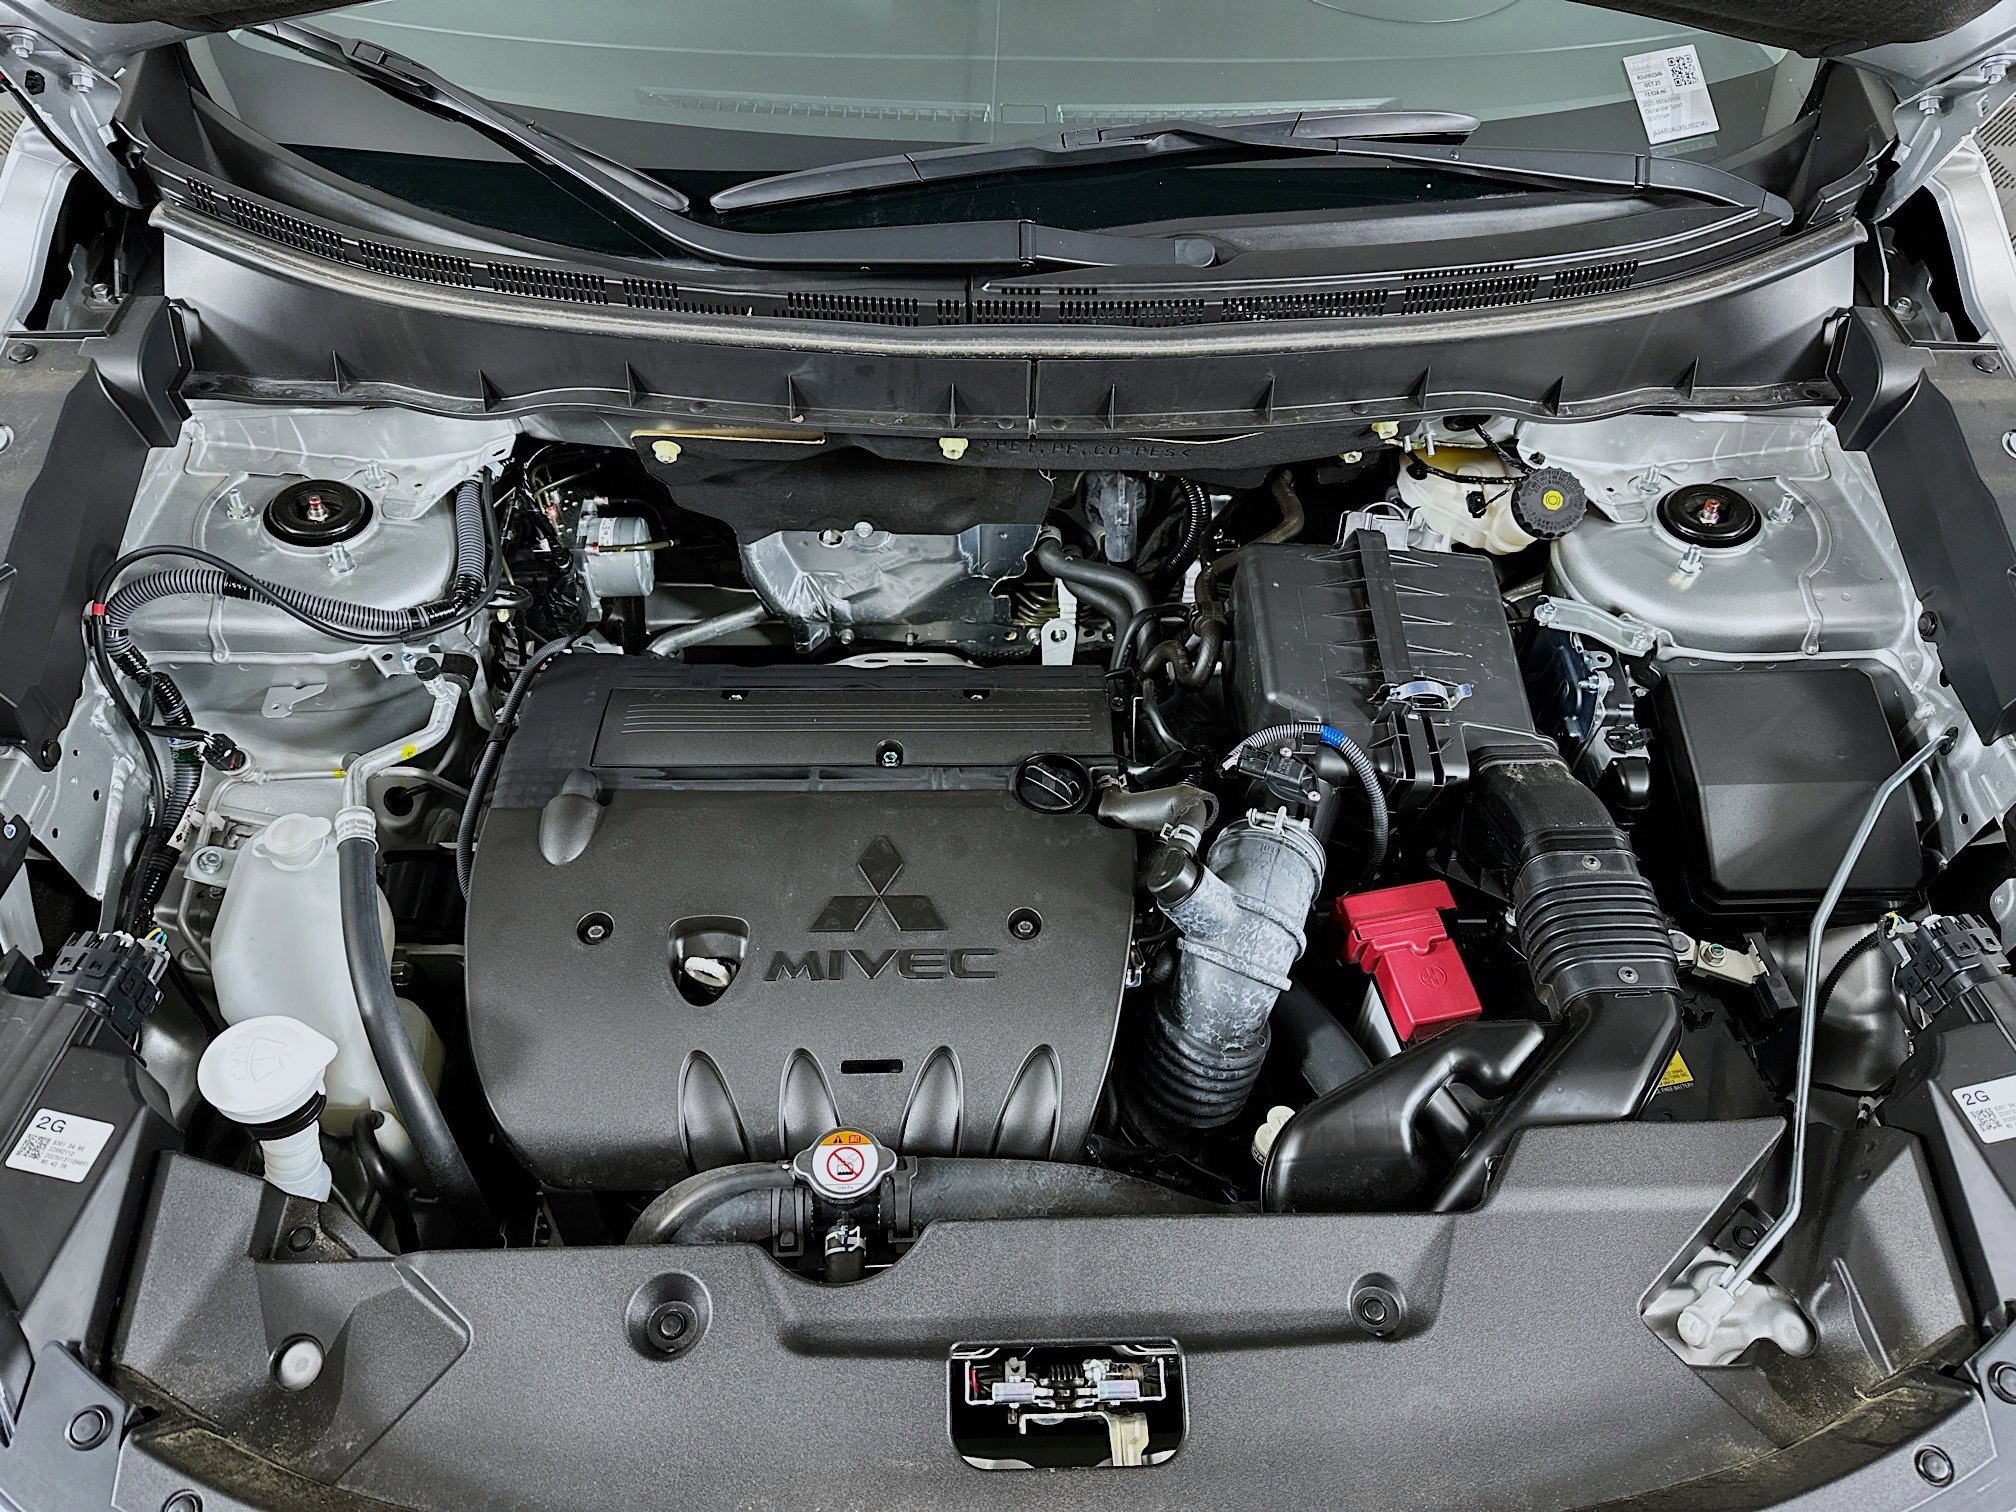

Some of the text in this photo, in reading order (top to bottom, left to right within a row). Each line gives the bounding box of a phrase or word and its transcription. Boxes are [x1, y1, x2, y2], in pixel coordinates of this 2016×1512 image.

[763, 948, 997, 981] MIVEC
[1674, 1082, 1694, 1091] BATTERY
[1962, 1090, 1991, 1106] 2G
[36, 1116, 67, 1134] 2G
